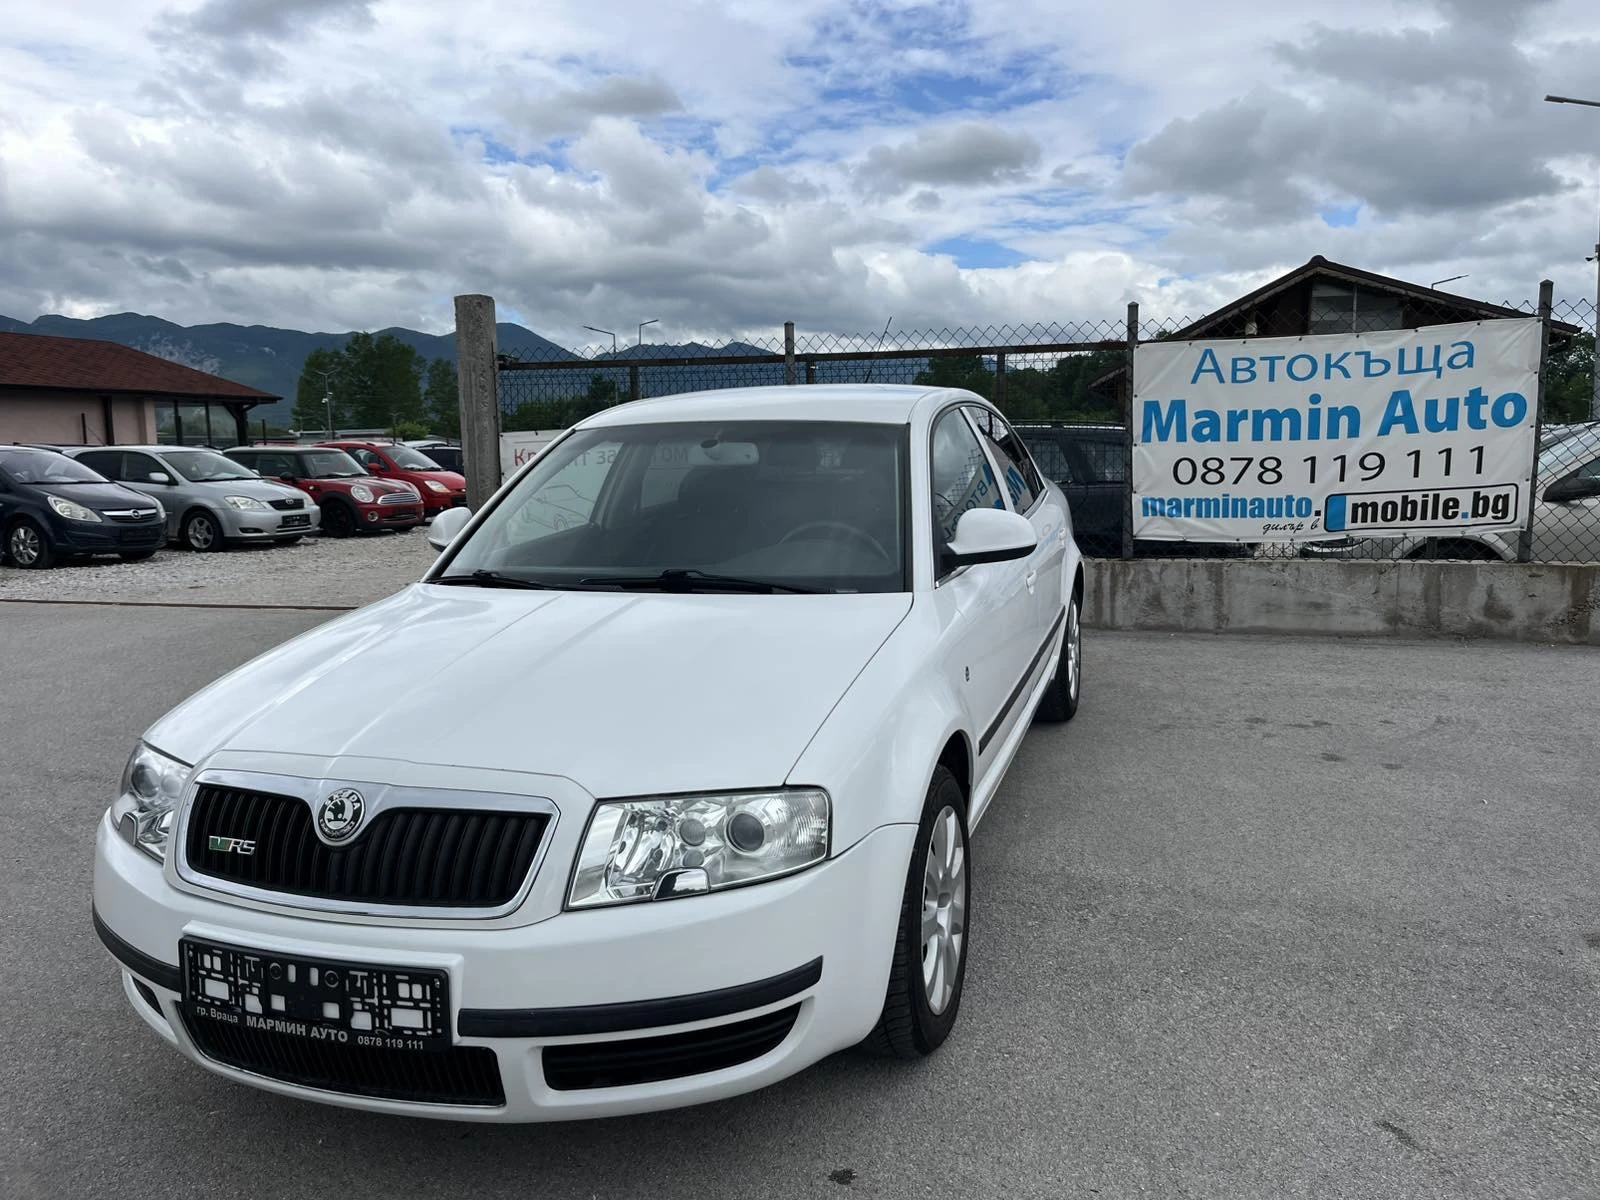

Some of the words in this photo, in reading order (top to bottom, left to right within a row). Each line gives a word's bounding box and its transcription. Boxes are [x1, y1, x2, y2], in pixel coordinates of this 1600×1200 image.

[1190, 340, 1475, 385] Автокъща
[1141, 393, 1360, 443] Marmin
[1377, 386, 1527, 437] Auto
[1172, 456, 1283, 486] 0878
[1302, 451, 1386, 484] 119
[1406, 445, 1485, 479] 111
[1350, 490, 1510, 525] mobile.bg
[210, 1007, 239, 1024] Враца
[246, 1015, 307, 1037] МАРМИН
[310, 1025, 348, 1042] АУТО
[357, 1035, 382, 1047] 0878
[385, 1038, 404, 1049] 119
[406, 1040, 424, 1050] 111
